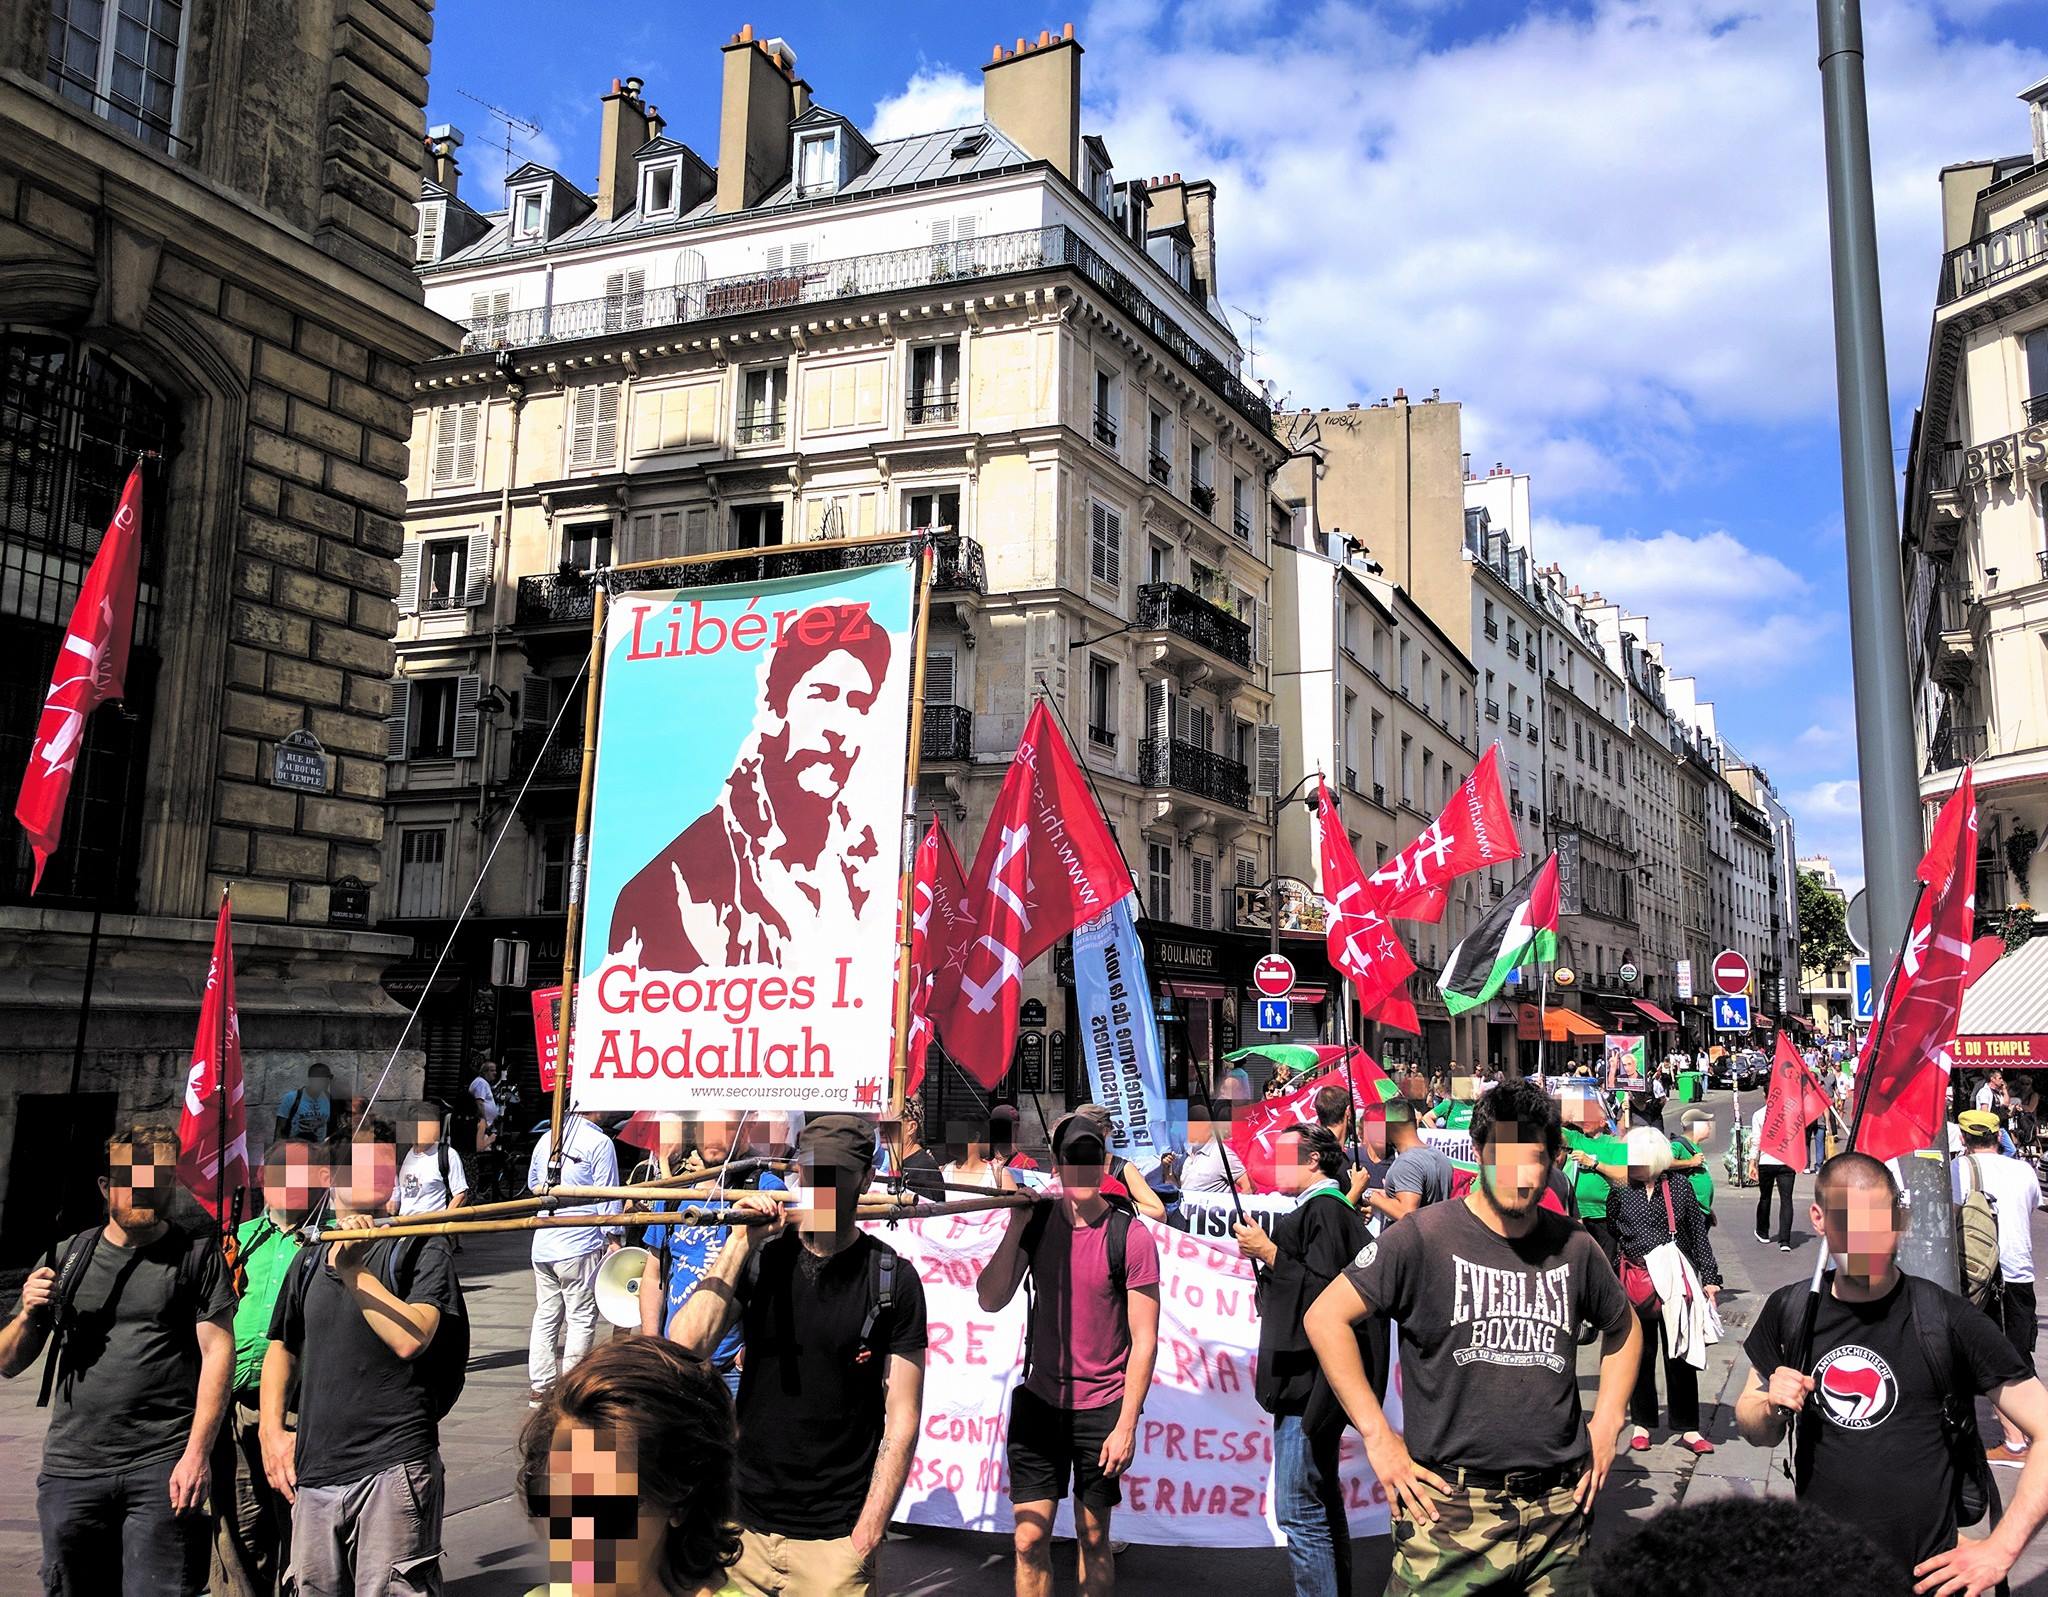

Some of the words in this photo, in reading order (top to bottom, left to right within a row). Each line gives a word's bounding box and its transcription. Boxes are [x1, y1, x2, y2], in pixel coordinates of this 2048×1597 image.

[1963, 217, 2048, 286] HOTE
[1963, 427, 2046, 485] BRIS
[626, 596, 871, 662] Libérez
[280, 761, 321, 776] FAUBOURG
[287, 753, 304, 764] RUE
[305, 756, 316, 766] DU
[277, 771, 289, 780] DU
[290, 773, 321, 786] TEMPLE
[1557, 835, 1571, 913] SAUNA
[537, 940, 560, 959] AU
[1160, 943, 1213, 967] BOULANGER
[597, 964, 815, 1024] Georges
[832, 957, 864, 1008] I.
[590, 1026, 834, 1080] Abdallah
[1954, 1039, 1961, 1056] É
[1964, 1041, 1981, 1056] DU
[1985, 1041, 2031, 1056] TEMPLE
[690, 1084, 849, 1101] www.secoursrouge.org
[1450, 1254, 1572, 1335] EVERLAST
[926, 1321, 995, 1366] RE
[1470, 1317, 1557, 1353] BOXING
[1535, 1354, 1545, 1362] TO
[1546, 1357, 1560, 1368] WIN
[1817, 1346, 1891, 1381] ANTIFASCHISTISCHE
[1832, 1415, 1871, 1427] AKTION
